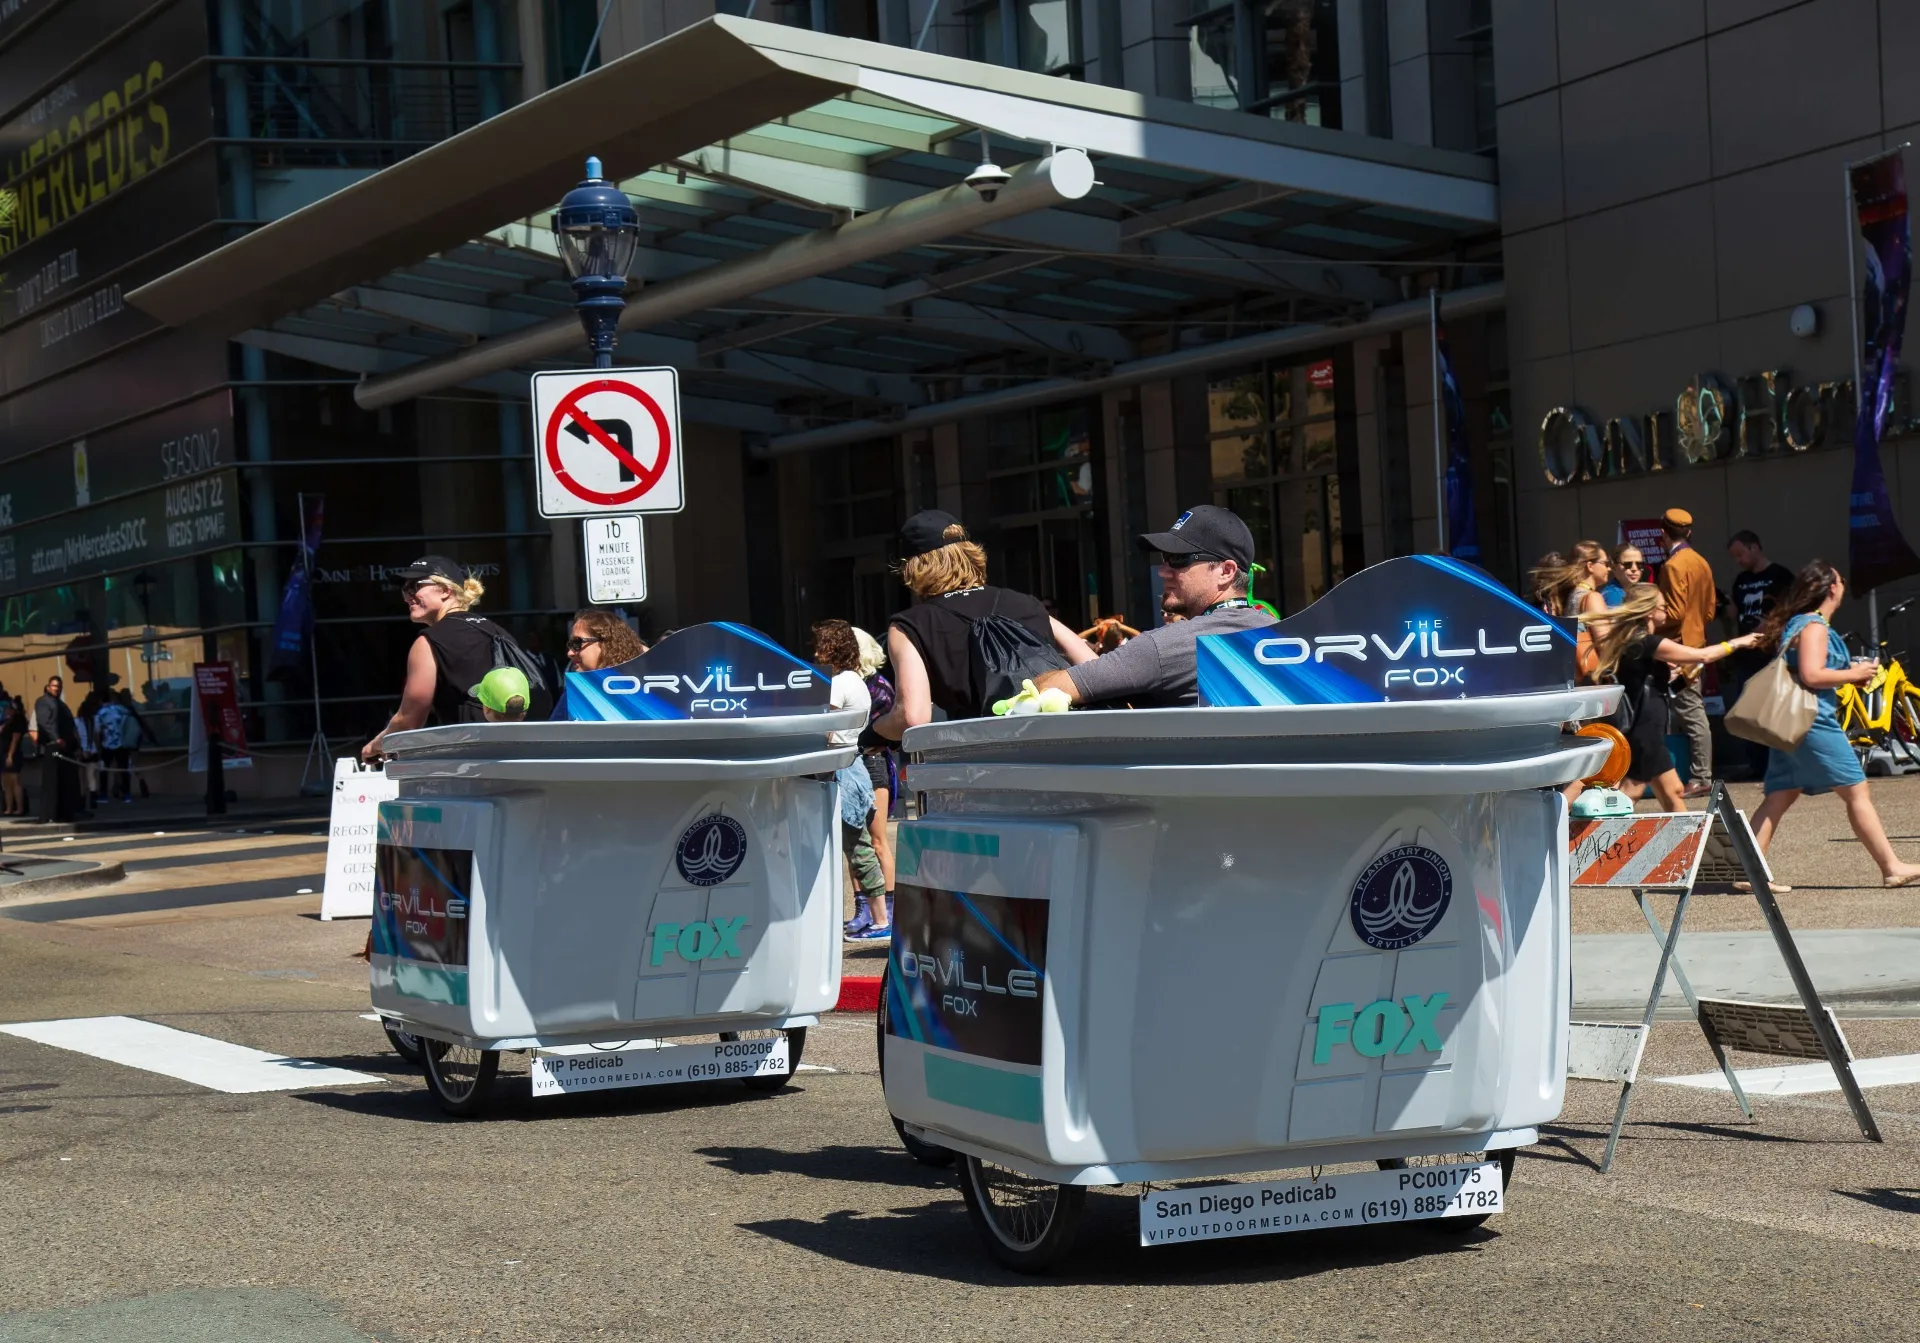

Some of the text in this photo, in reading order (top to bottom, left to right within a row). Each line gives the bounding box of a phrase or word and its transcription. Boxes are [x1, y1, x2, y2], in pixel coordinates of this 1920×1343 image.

[8, 60, 170, 248] MERCEDES
[161, 428, 221, 480] SEASON 2
[1540, 405, 1672, 486] OMNI
[166, 477, 224, 518] AUGUST 22
[166, 520, 192, 548] WEDS
[605, 523, 621, 539] 10
[599, 542, 630, 554] MINUTE
[596, 556, 634, 566] PASSENGER
[602, 567, 630, 576] LOADING
[1404, 619, 1442, 629] THE
[1253, 625, 1553, 666] ORVILLE
[705, 665, 733, 673] THE
[1384, 666, 1465, 688] FOX
[602, 670, 812, 695] ORVILLE
[690, 698, 748, 712] FOX
[681, 816, 746, 844] PLANETARY UNION
[686, 875, 727, 886] ORVILLE
[1357, 847, 1451, 890] PLANETARY UNION
[381, 892, 466, 918] ORVILLE
[406, 920, 427, 935] FOX
[1367, 930, 1424, 949] ORVILLE
[650, 915, 748, 967] FOX
[901, 951, 1037, 998] ORVILLE
[942, 994, 977, 1018] FOX
[1313, 992, 1451, 1065] FOX
[714, 1042, 773, 1058] PC00206
[542, 1055, 623, 1073] VIP Pedicab
[687, 1058, 784, 1079] (619) 885-1782
[537, 1069, 683, 1089] VIPOUTDOORMEDIA.COM
[1399, 1167, 1481, 1191] PC00175
[1156, 1183, 1337, 1219] San Diego Pedicab
[1361, 1190, 1499, 1223] (619) 885-1782
[1149, 1208, 1354, 1241] VIPOUTDOORMEDIA.COM
